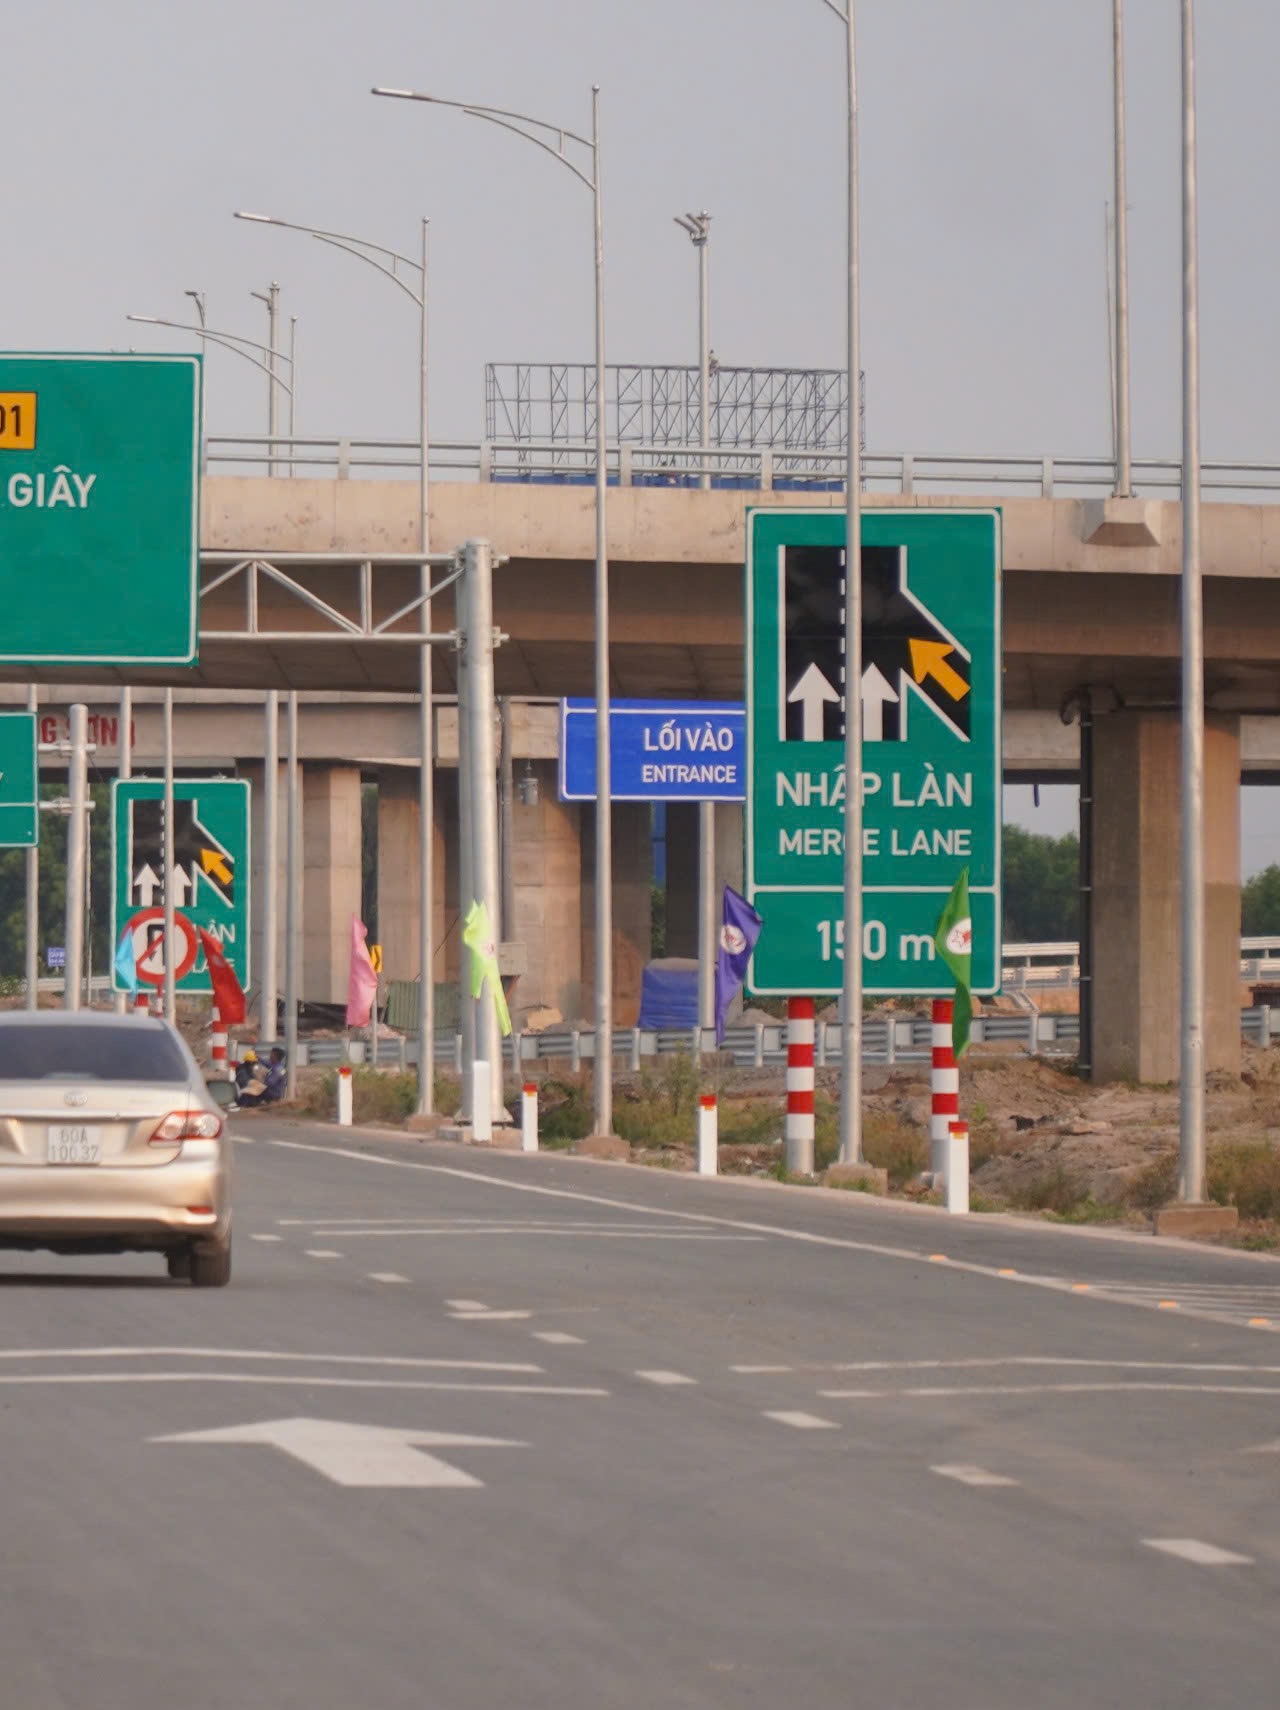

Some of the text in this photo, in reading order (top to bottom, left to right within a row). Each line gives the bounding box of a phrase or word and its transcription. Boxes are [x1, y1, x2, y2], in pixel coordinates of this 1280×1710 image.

[7, 464, 97, 508] GIÂY
[643, 719, 734, 752] LỐI VÀO
[641, 764, 737, 784] ENTRANCE
[776, 762, 973, 814] NHẬP LÀN
[778, 829, 972, 857] MERE LANE
[900, 935, 936, 961] m
